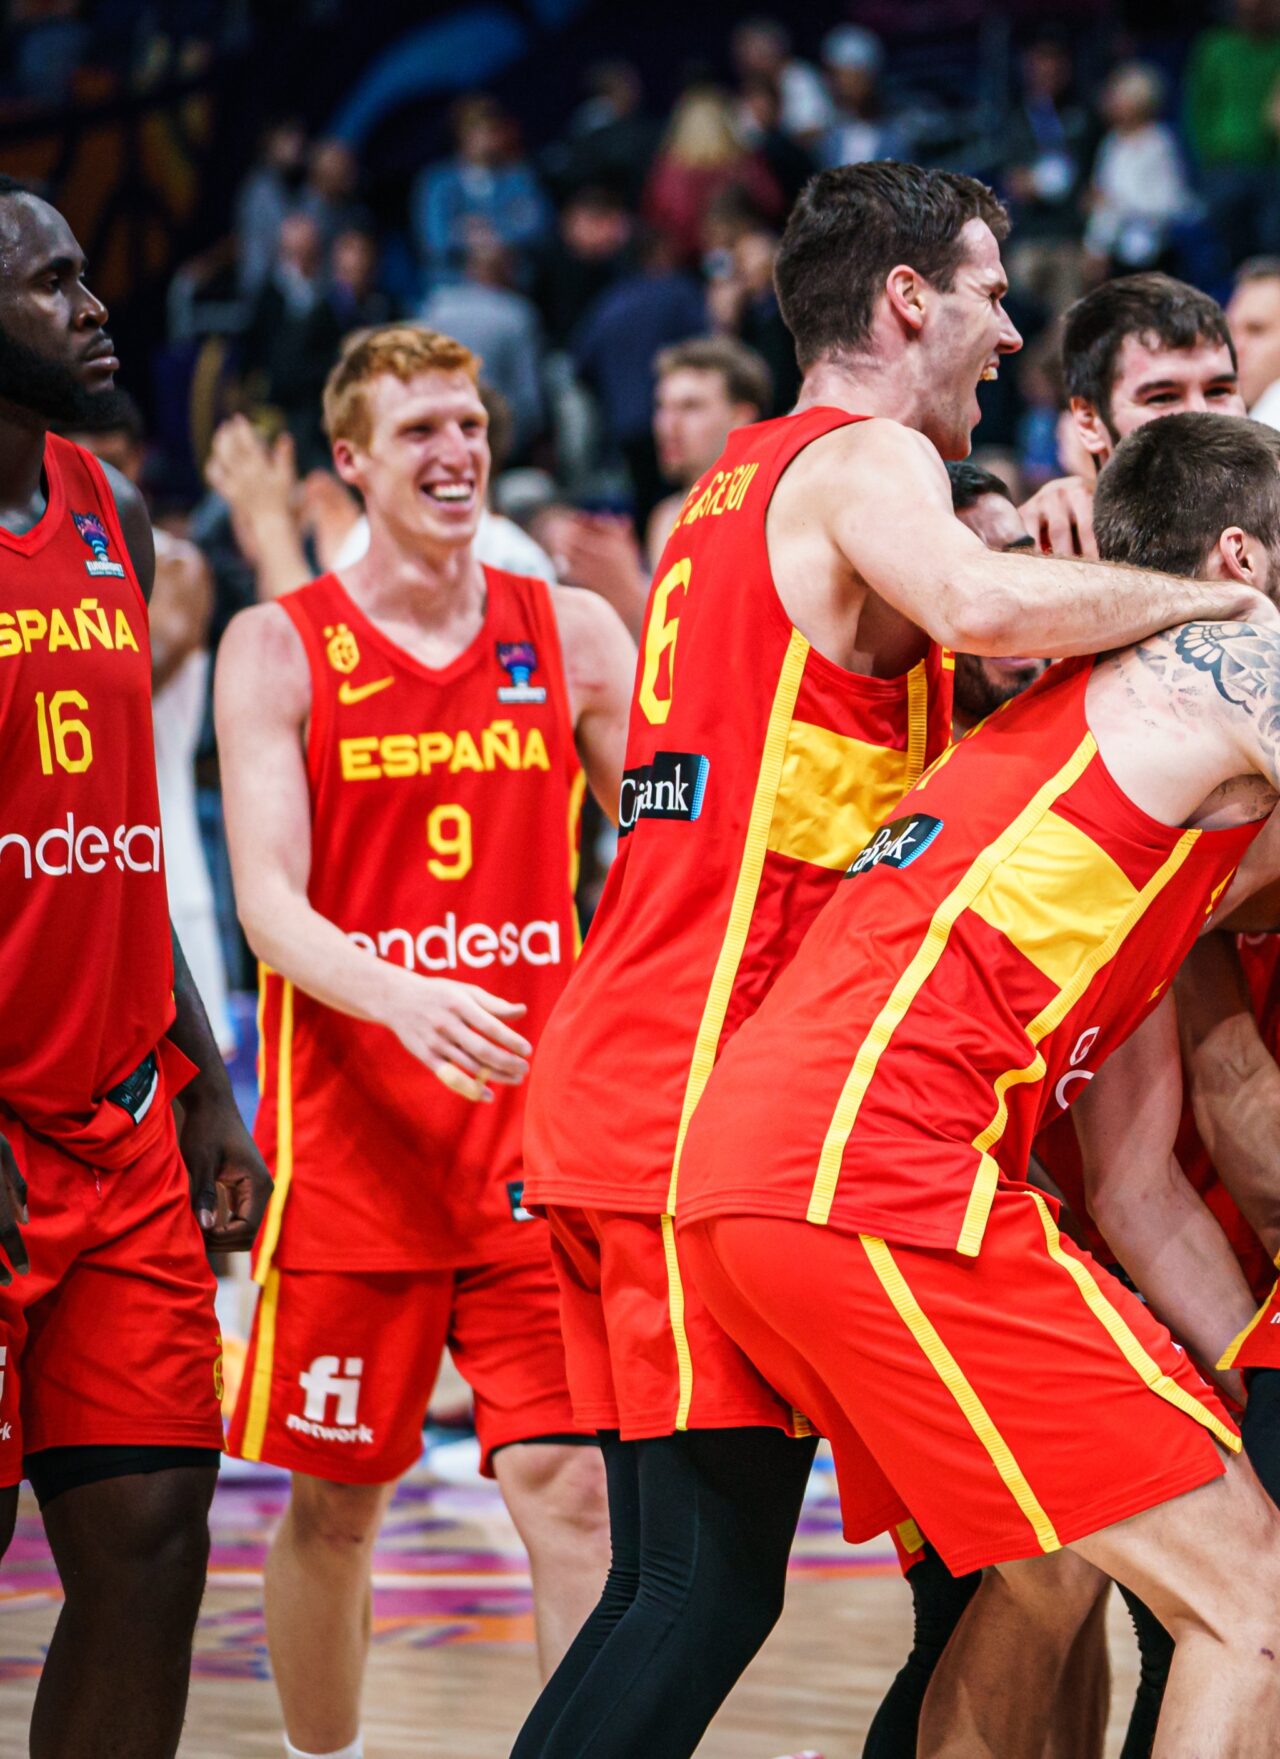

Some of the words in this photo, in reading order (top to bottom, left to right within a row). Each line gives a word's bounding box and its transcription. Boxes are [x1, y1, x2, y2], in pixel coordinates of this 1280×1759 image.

[638, 556, 693, 725] 6
[35, 690, 93, 775] 16
[339, 719, 550, 781] ESPAÑA
[427, 804, 473, 880] 9
[299, 1355, 363, 1426] fi
[286, 1413, 374, 1443] network
